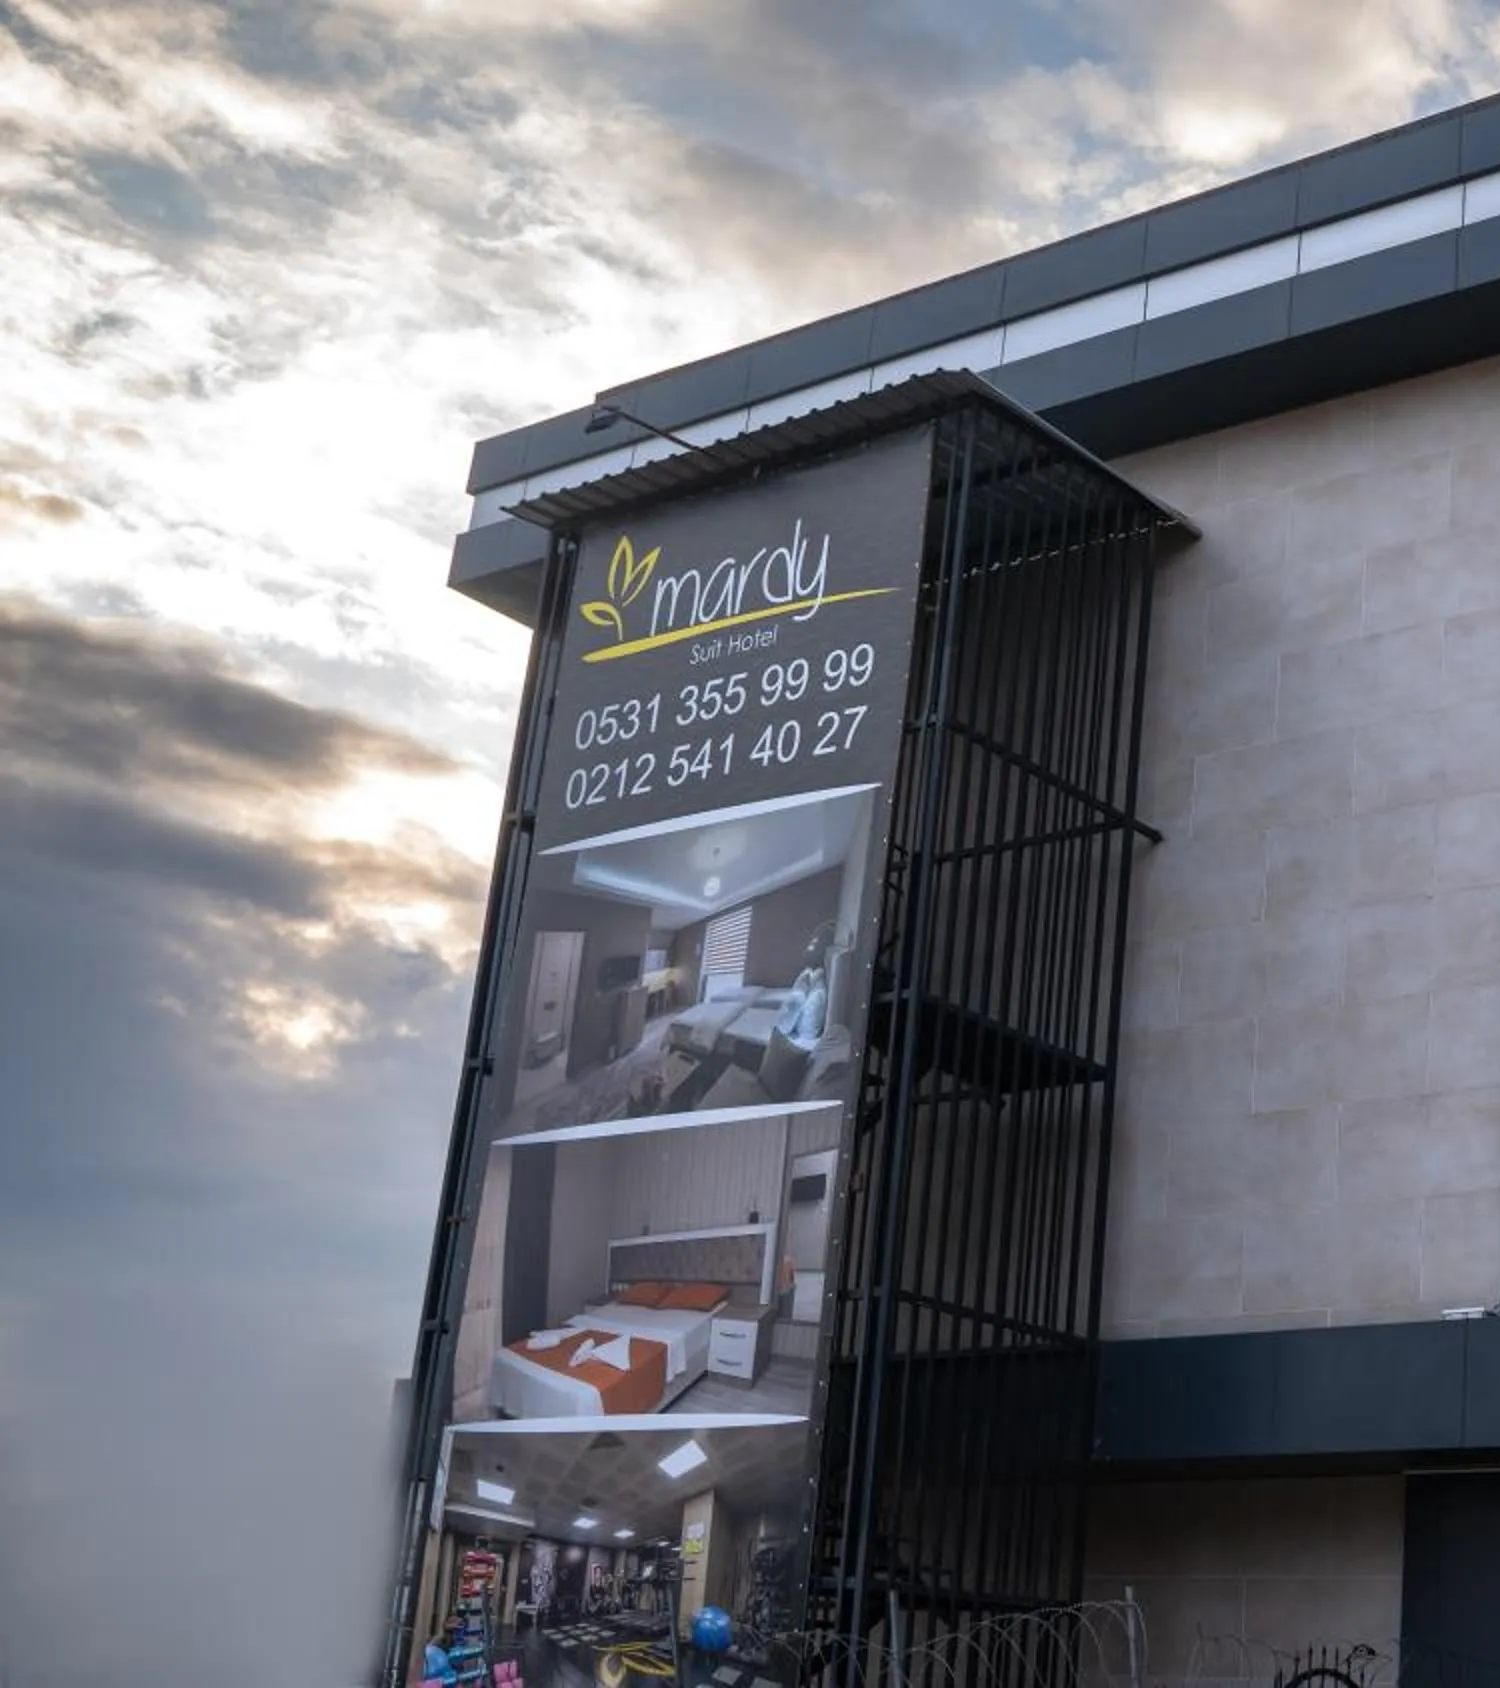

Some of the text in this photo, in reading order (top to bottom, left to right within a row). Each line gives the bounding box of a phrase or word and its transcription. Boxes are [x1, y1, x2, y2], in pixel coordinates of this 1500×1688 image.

[650, 518, 829, 636] mardy
[575, 643, 875, 749] 0531 355 99 99
[689, 625, 778, 666] Suit Hotel
[566, 706, 868, 809] 0212 541 40 27
